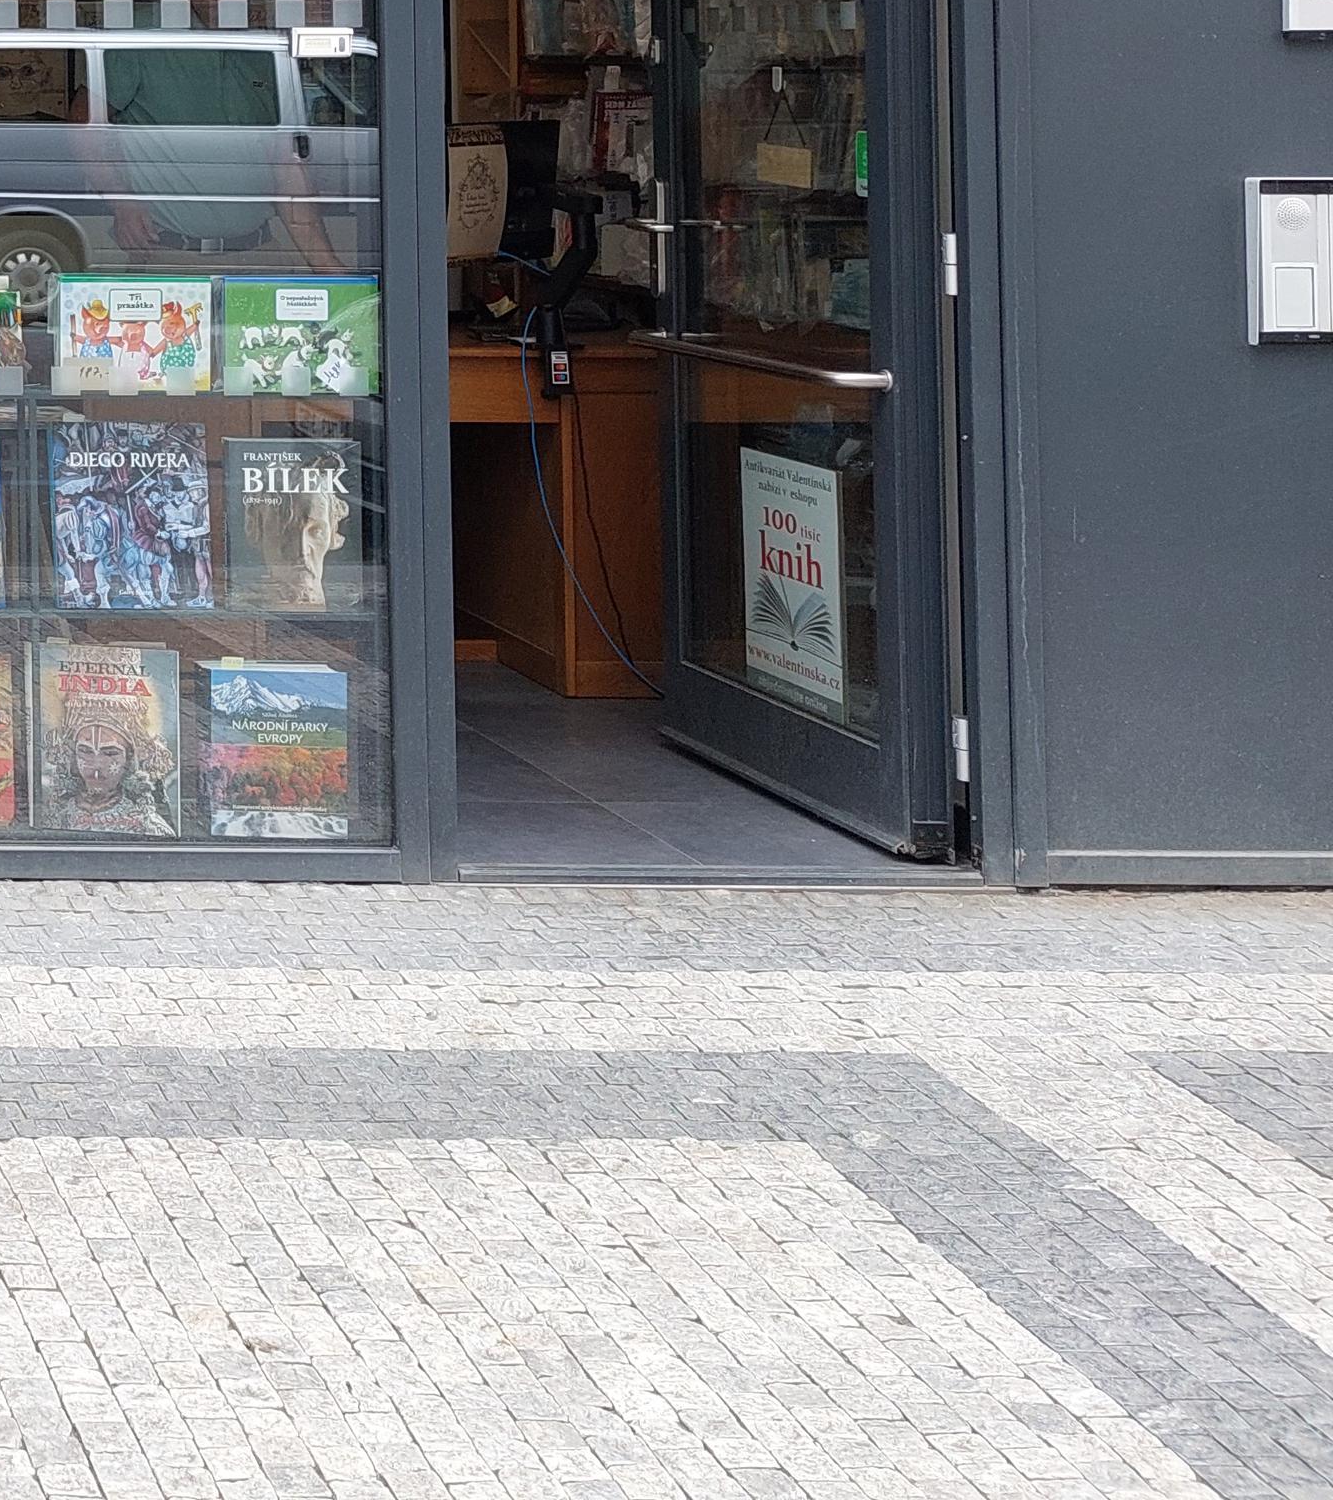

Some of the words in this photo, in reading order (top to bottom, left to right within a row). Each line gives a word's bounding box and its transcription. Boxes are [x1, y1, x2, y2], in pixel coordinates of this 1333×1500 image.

[117, 301, 155, 310] prasátka
[69, 451, 125, 468] DIEGO
[131, 451, 191, 468] RIVERA
[243, 451, 302, 462] FRANTIŠEK
[242, 463, 349, 495] BÍLEK
[744, 459, 785, 480] Antikvariát
[787, 465, 831, 492] Valentinská
[790, 488, 817, 507] eshopu
[763, 506, 797, 535] 100
[759, 530, 823, 589] knih
[59, 661, 151, 676] ETERNAL
[747, 644, 841, 690] www.valentinska.cz
[59, 674, 152, 697] INDIA
[232, 719, 289, 732] NÁRODNÍ
[290, 721, 328, 732] PARKY
[257, 732, 303, 745] EVROPY
